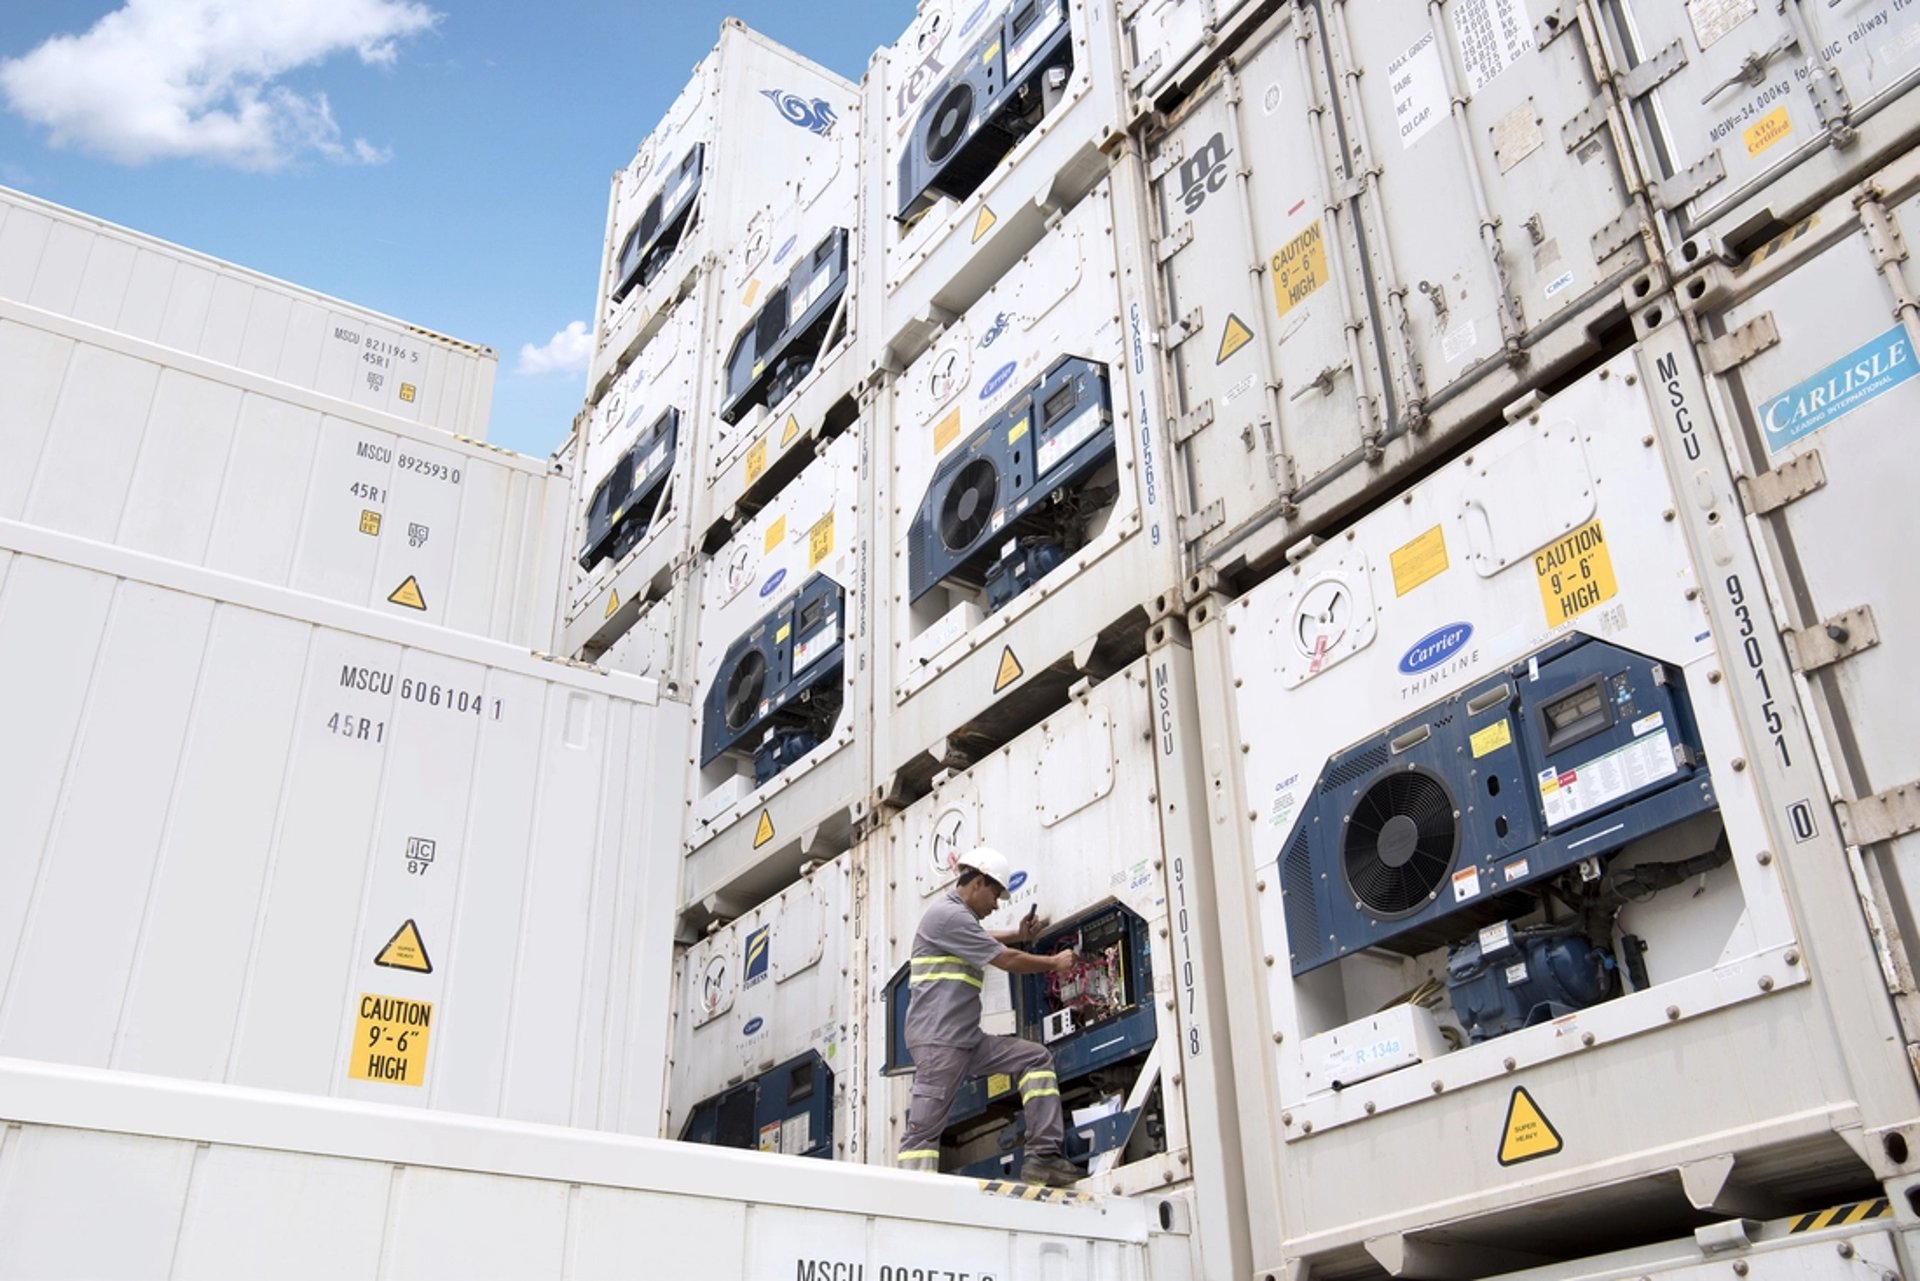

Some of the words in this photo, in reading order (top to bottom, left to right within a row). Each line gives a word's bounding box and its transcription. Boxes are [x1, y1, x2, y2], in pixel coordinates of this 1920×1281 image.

[1821, 41, 1843, 62] UIC
[1847, 9, 1888, 45] railway
[1393, 73, 1412, 95] TARE
[1396, 97, 1412, 116] NET
[1747, 120, 1790, 154] Certified
[1754, 119, 1775, 139] ATO
[1272, 223, 1320, 272] CAUTION
[1288, 271, 1316, 306] HIGH
[334, 327, 360, 344] MSCU
[365, 338, 406, 359] 821196
[362, 352, 390, 369] 45R1
[1765, 339, 1907, 434] CARLISLE
[1790, 411, 1826, 435] LEASING
[1827, 375, 1893, 414] INTERNATIONAL
[357, 441, 392, 464] MSCU
[398, 454, 447, 481] 892593
[350, 482, 387, 504] 45R1
[1151, 524, 1160, 546] 9
[1534, 523, 1604, 577] CAUTION
[1560, 580, 1601, 618] HIGH
[1656, 351, 1700, 461] MSCU
[1725, 574, 1792, 768] 930151
[1792, 803, 1813, 839] 0
[1408, 627, 1464, 667] Carrier
[340, 665, 393, 695] MSCU
[401, 678, 482, 715] 606104
[1402, 649, 1480, 700] THINLINE
[328, 712, 384, 742] 45R1
[1155, 663, 1173, 756] MSCU
[1174, 857, 1195, 1015] 910107
[407, 860, 428, 875] 87
[361, 996, 431, 1027] CAUTION
[368, 1054, 407, 1081] HIGH
[1514, 1122, 1537, 1133] SUPER
[1515, 1131, 1538, 1143] HEAVY
